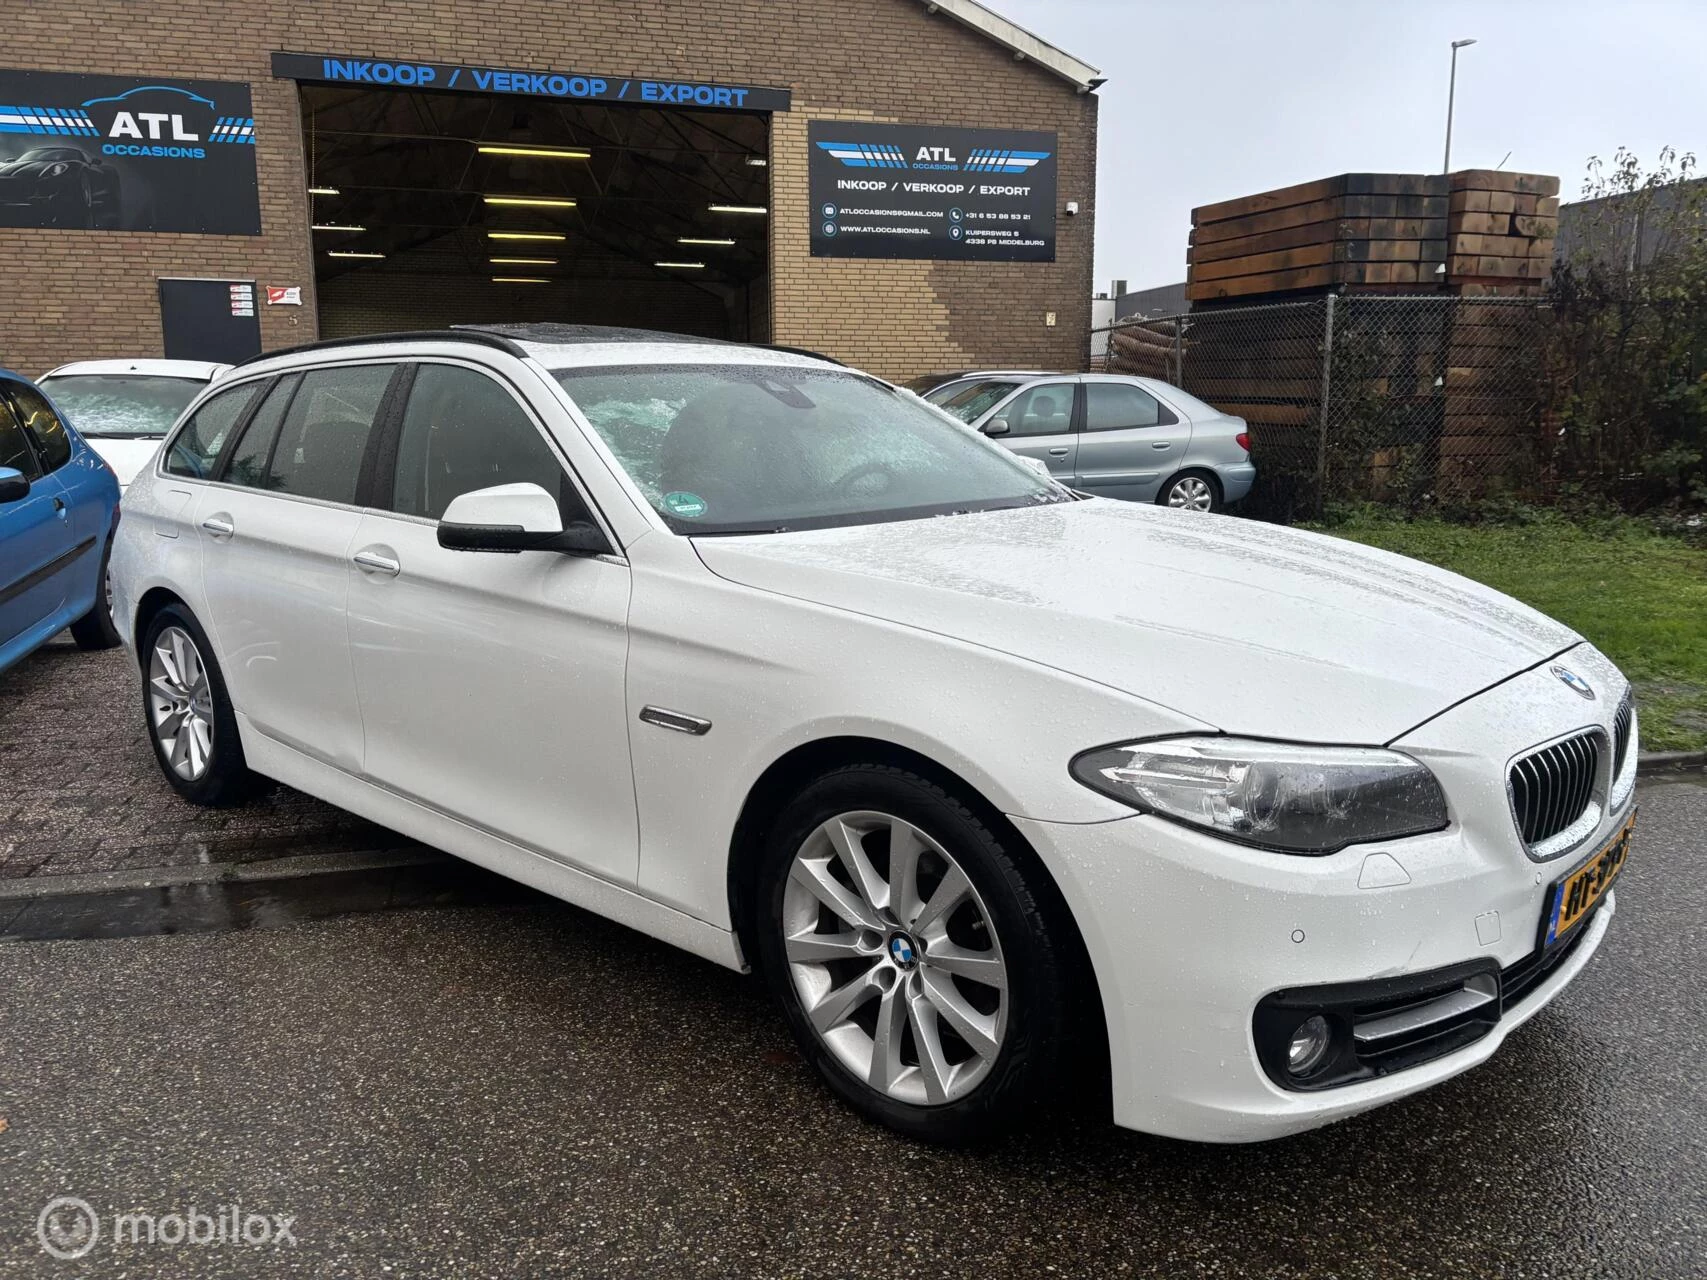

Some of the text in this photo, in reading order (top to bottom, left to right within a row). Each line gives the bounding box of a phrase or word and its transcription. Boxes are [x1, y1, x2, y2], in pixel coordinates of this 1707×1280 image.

[323, 59, 749, 108] INKOOP / VERKOOP / EXPORT
[108, 111, 199, 142] ATL
[102, 144, 206, 159] OCCASIONS
[915, 146, 957, 162] ATL
[912, 162, 959, 171] OCCASIONS
[837, 179, 1031, 197] INKOOP / VERKOOP / EXPORT
[840, 226, 931, 235] WWW.ATLOCCASIONS.NL
[998, 239, 1045, 247] MIDDELBURG
